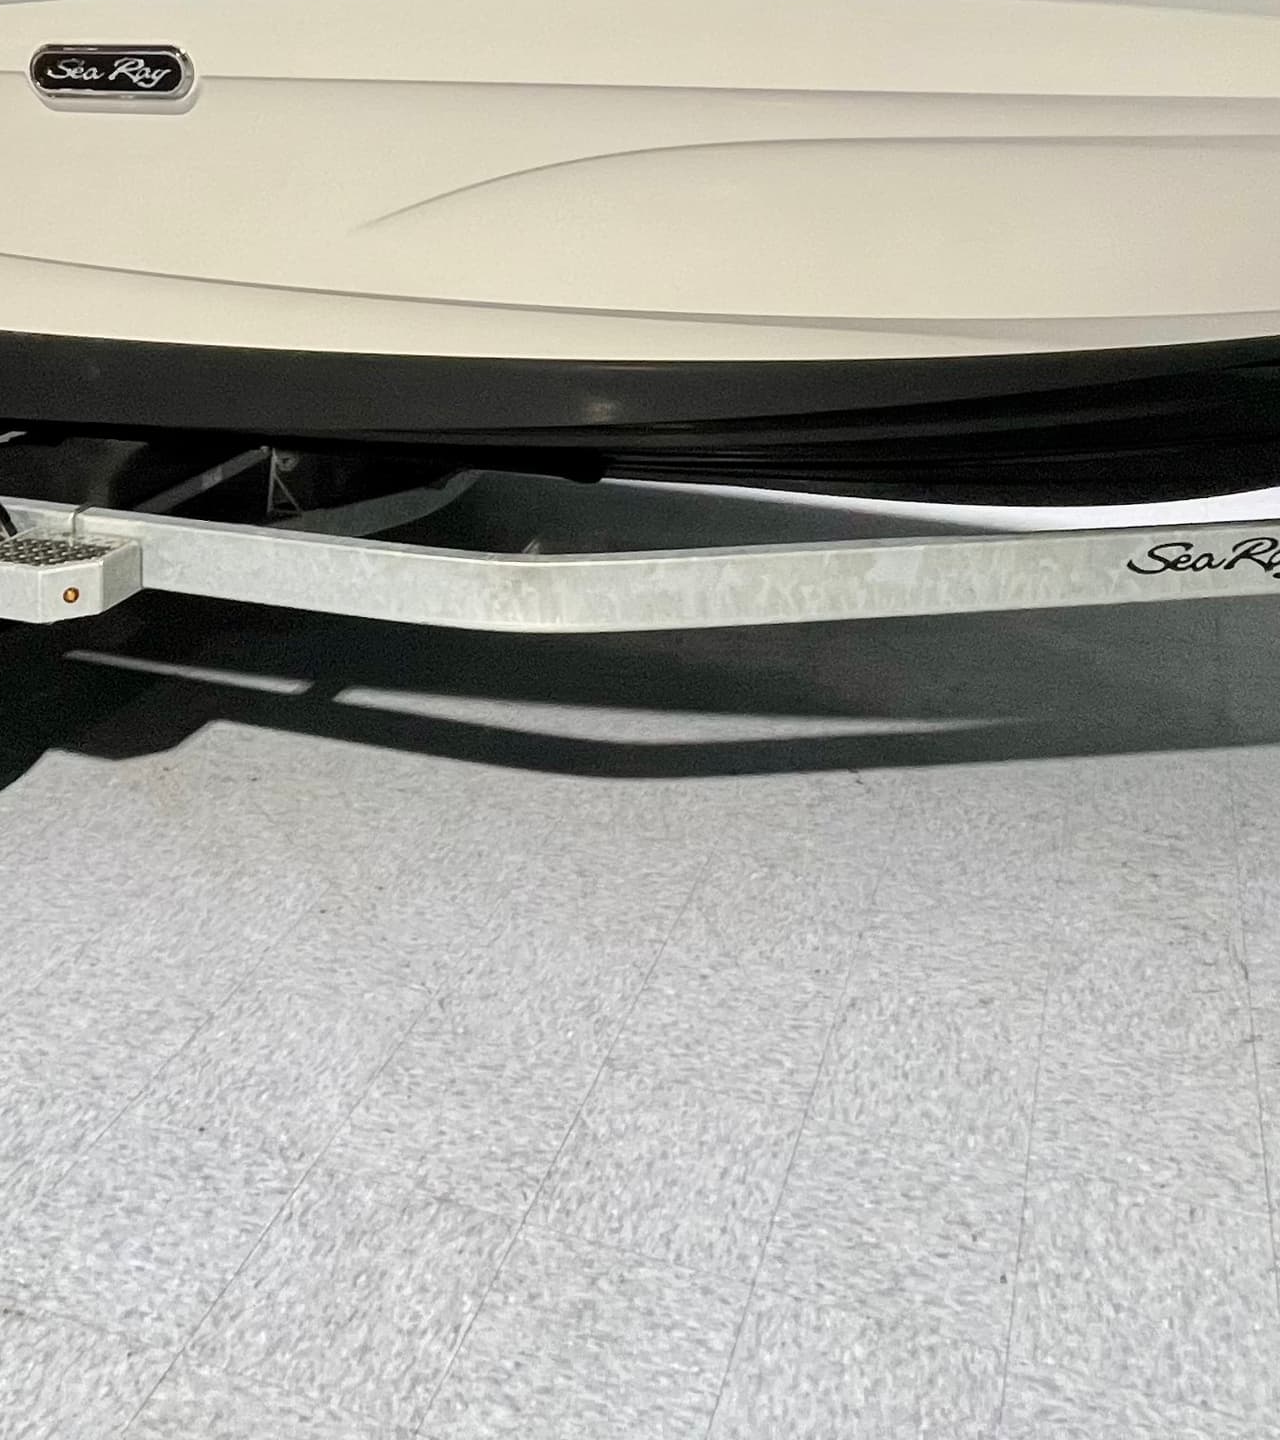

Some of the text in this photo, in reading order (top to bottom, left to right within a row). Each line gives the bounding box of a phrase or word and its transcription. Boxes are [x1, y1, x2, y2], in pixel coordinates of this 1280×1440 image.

[46, 57, 172, 88] Sea Ray
[1126, 542, 1228, 575] Sea
